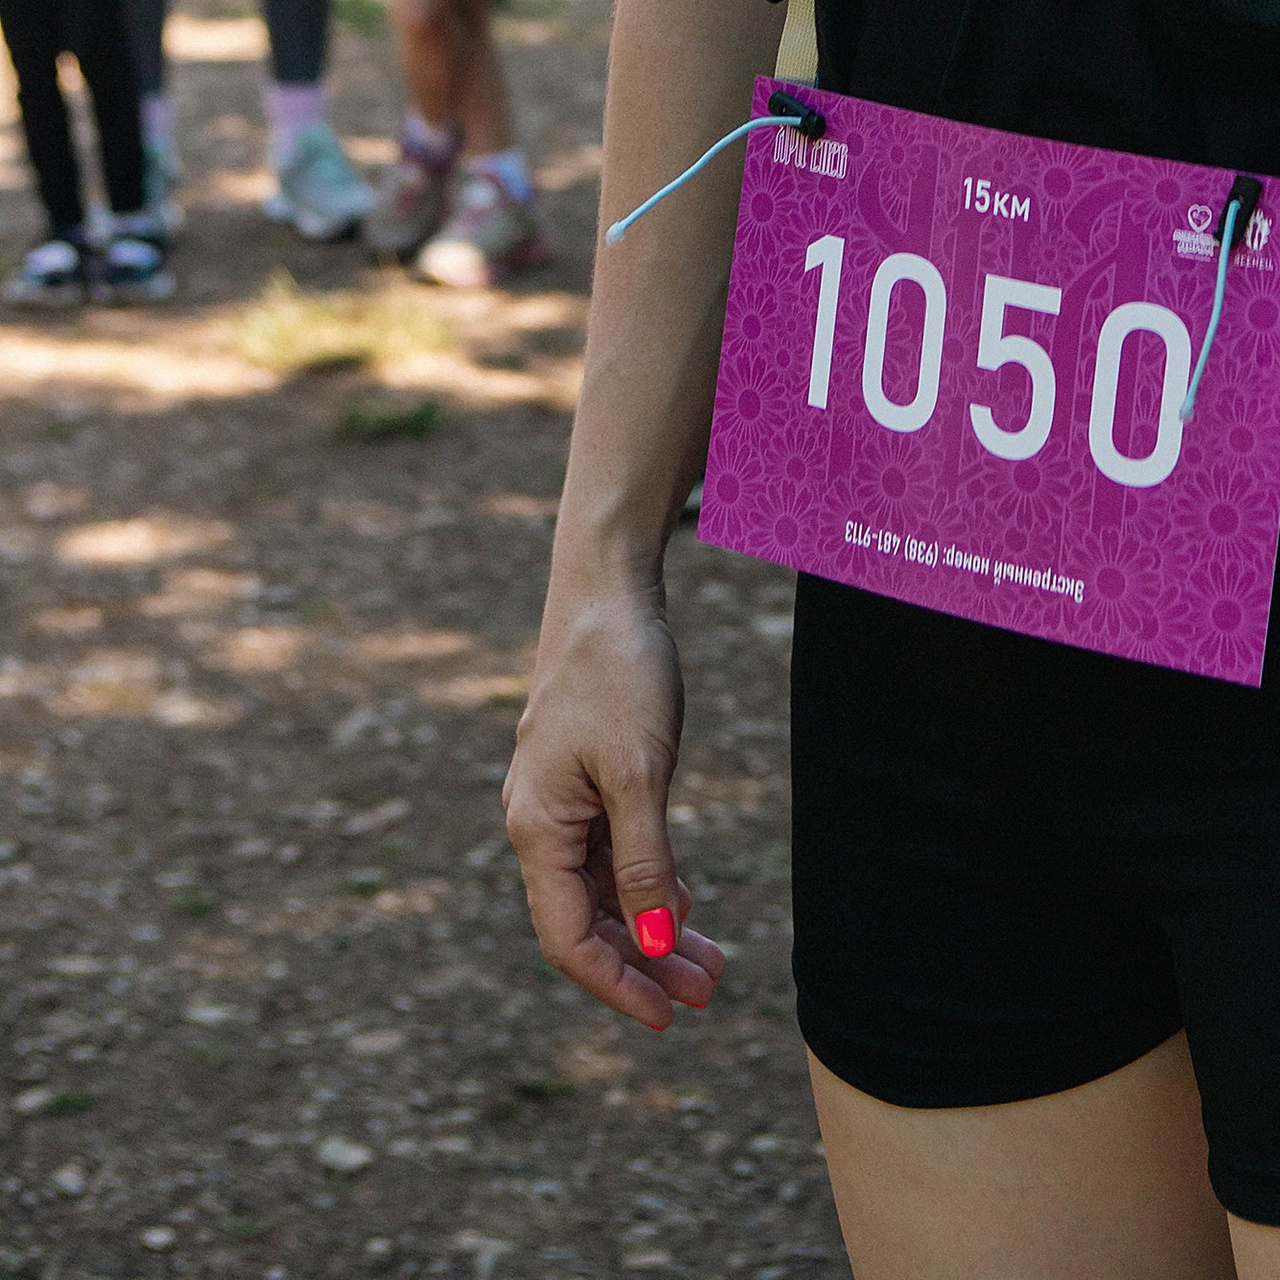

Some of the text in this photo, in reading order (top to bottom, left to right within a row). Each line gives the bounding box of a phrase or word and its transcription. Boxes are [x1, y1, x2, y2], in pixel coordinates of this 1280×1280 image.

[804, 234, 1192, 488] 1050
[844, 520, 1085, 603] Экстренный номер: (938) 481-9113
